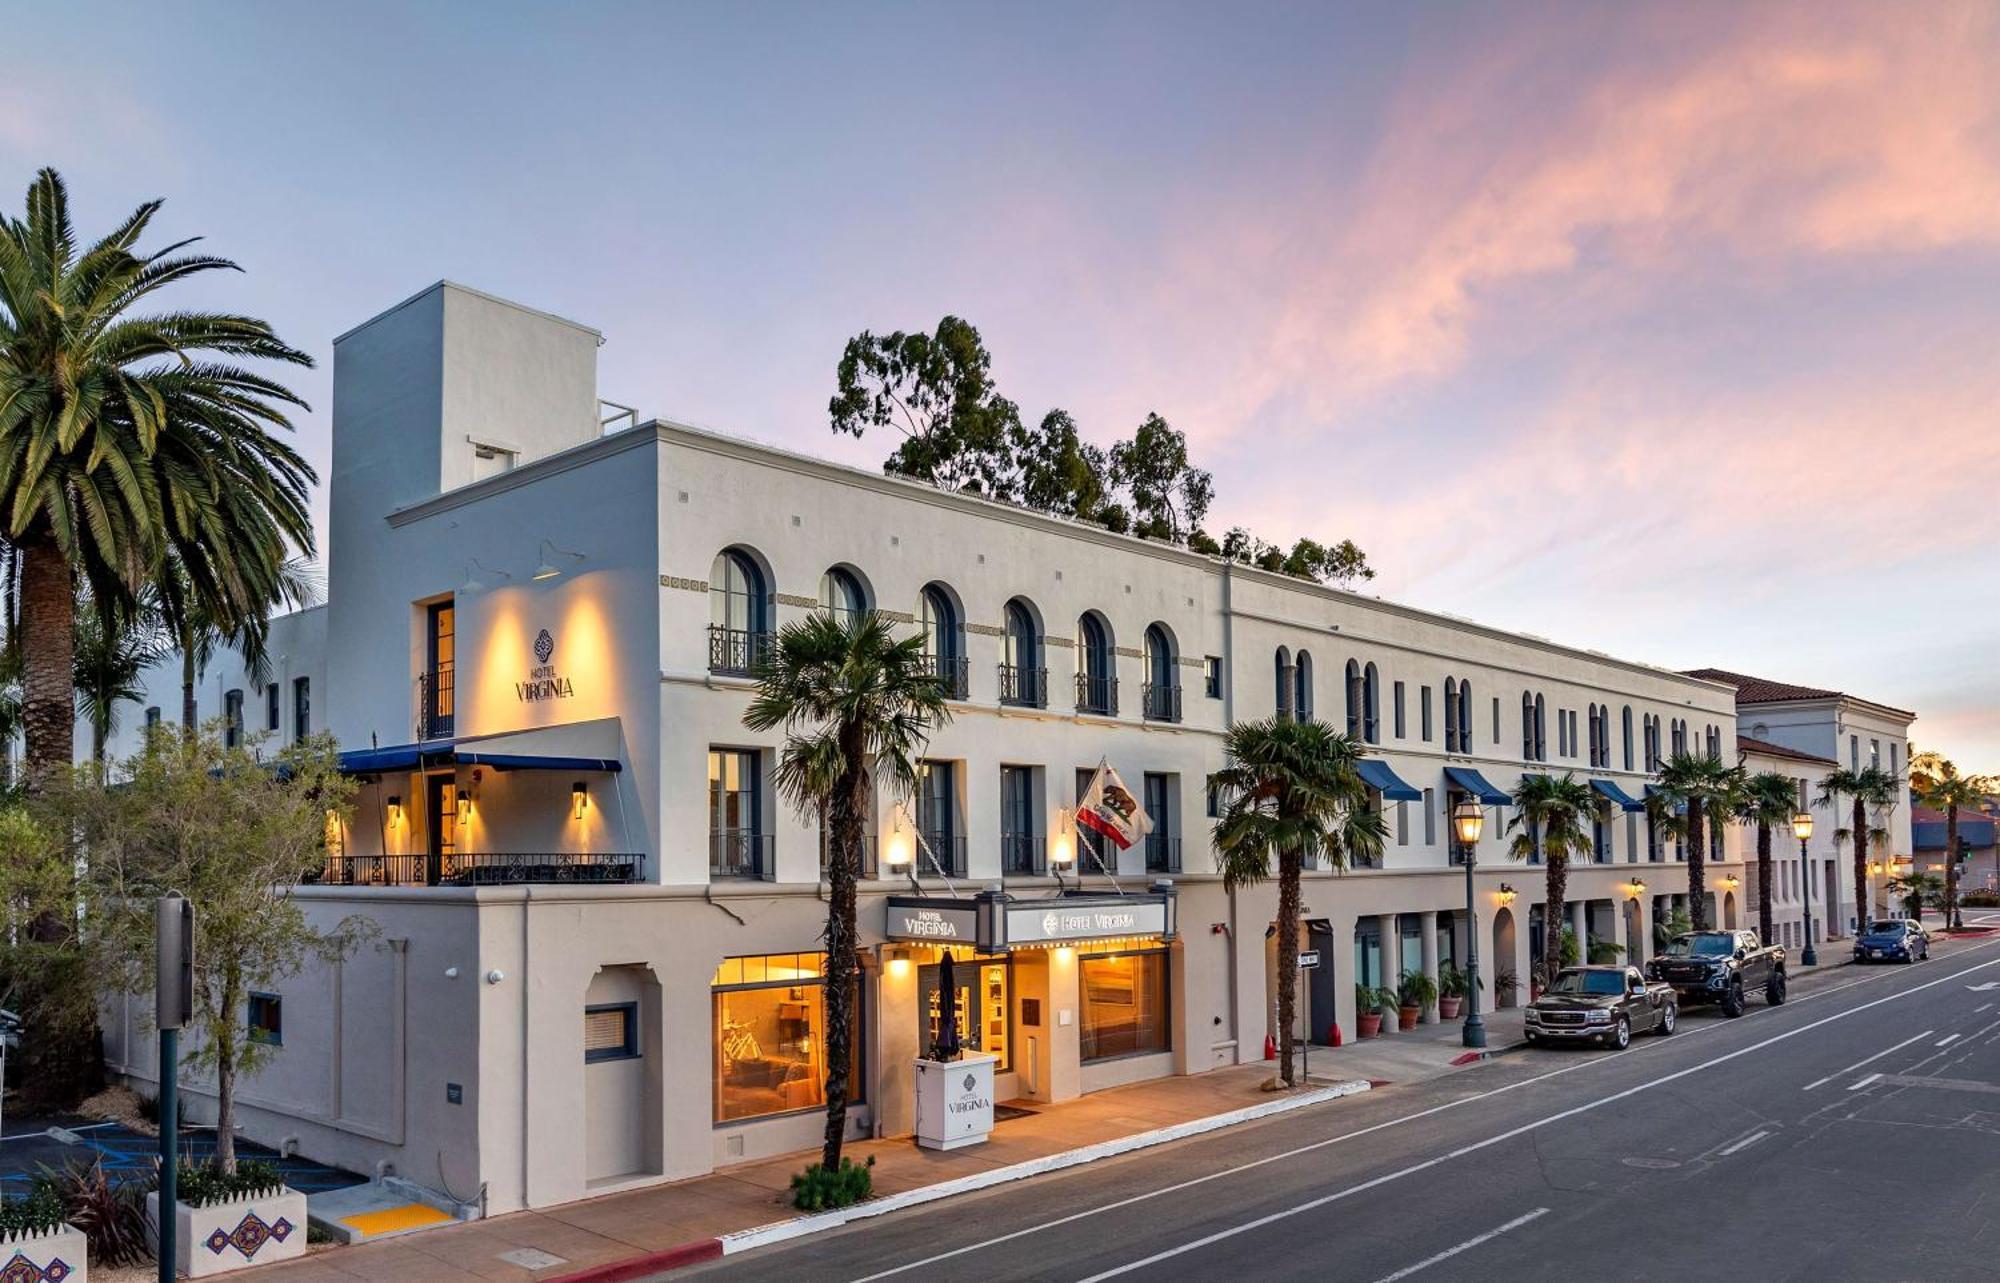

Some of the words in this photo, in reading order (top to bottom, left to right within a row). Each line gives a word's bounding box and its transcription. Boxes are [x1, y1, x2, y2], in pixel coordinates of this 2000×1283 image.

[530, 665, 557, 679] HOTEL
[515, 677, 574, 702] VIRGINIA
[918, 911, 943, 922] HOTEL
[1094, 913, 1134, 929] VIRGINIA
[904, 918, 957, 937] VIRGINIA
[948, 1098, 990, 1114] VIRGINIA
